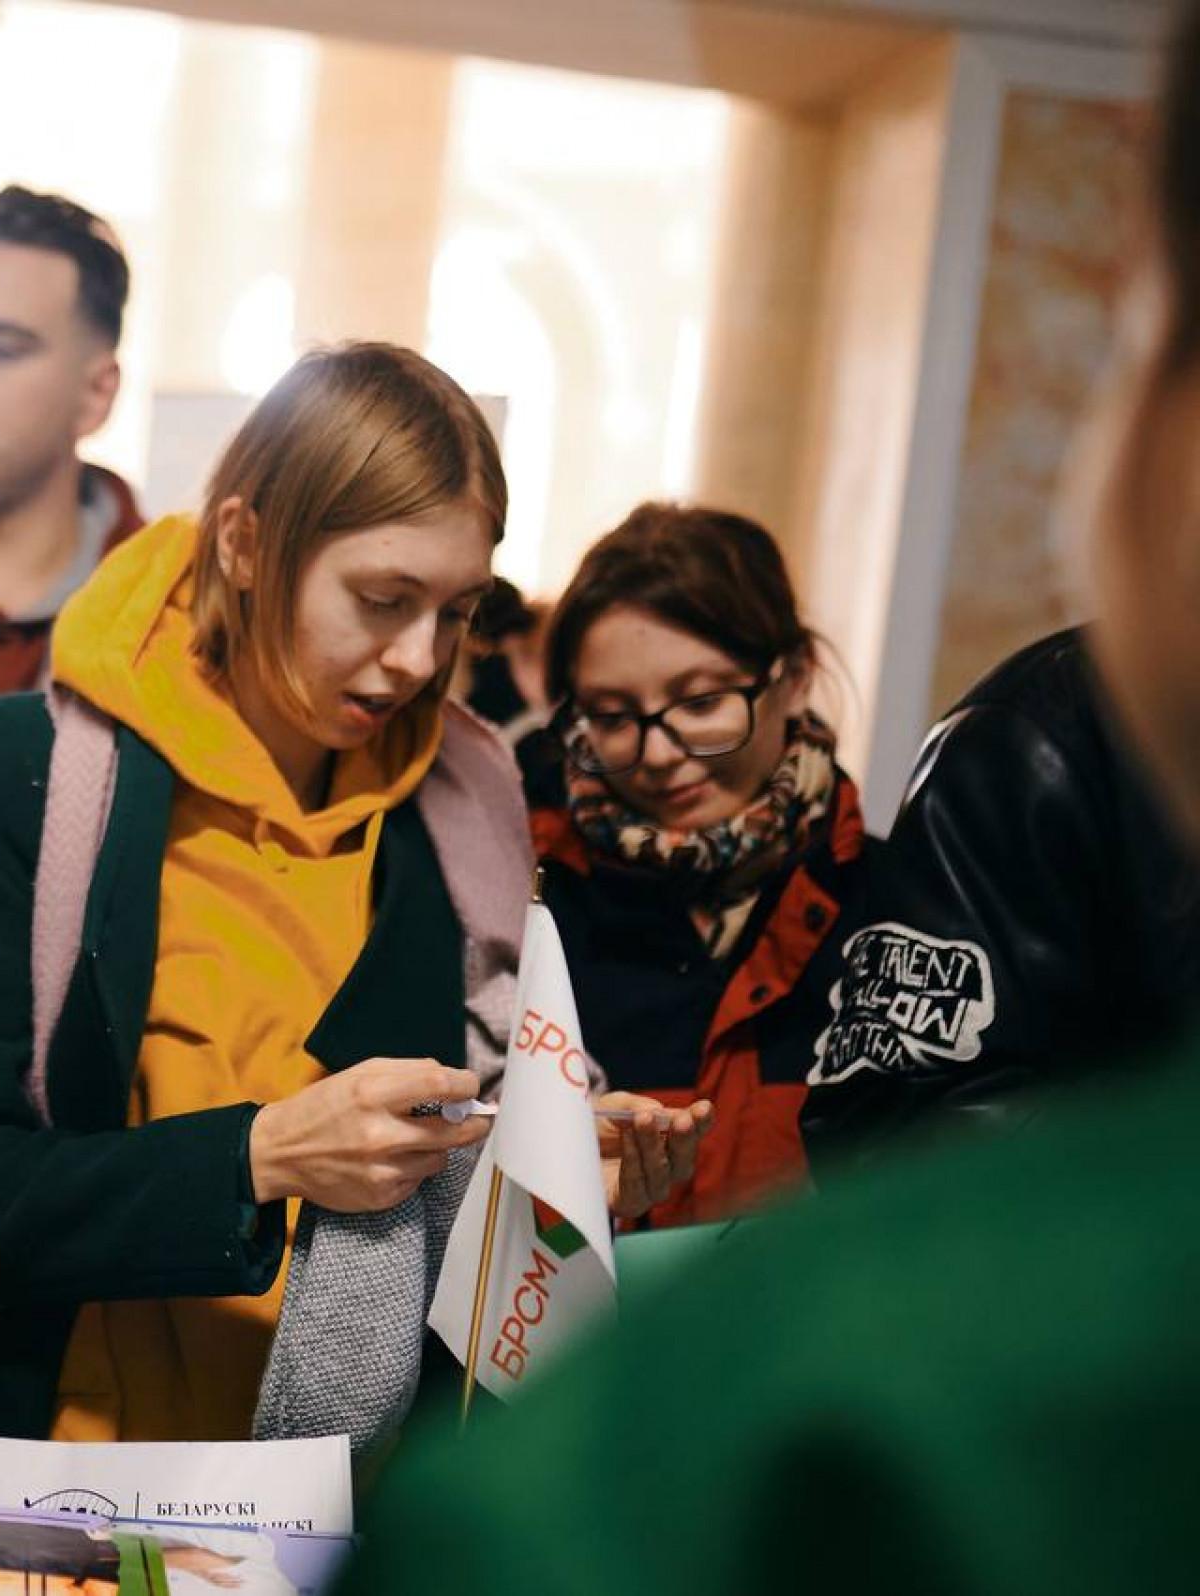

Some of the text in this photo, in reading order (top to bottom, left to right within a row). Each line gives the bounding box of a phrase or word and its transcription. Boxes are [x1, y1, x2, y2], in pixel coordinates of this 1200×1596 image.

[879, 934, 974, 990] TALENT
[515, 1009, 588, 1101] БРС
[490, 1248, 558, 1382] БРСМ
[156, 1502, 257, 1517] БЕЛАРУСКІ
